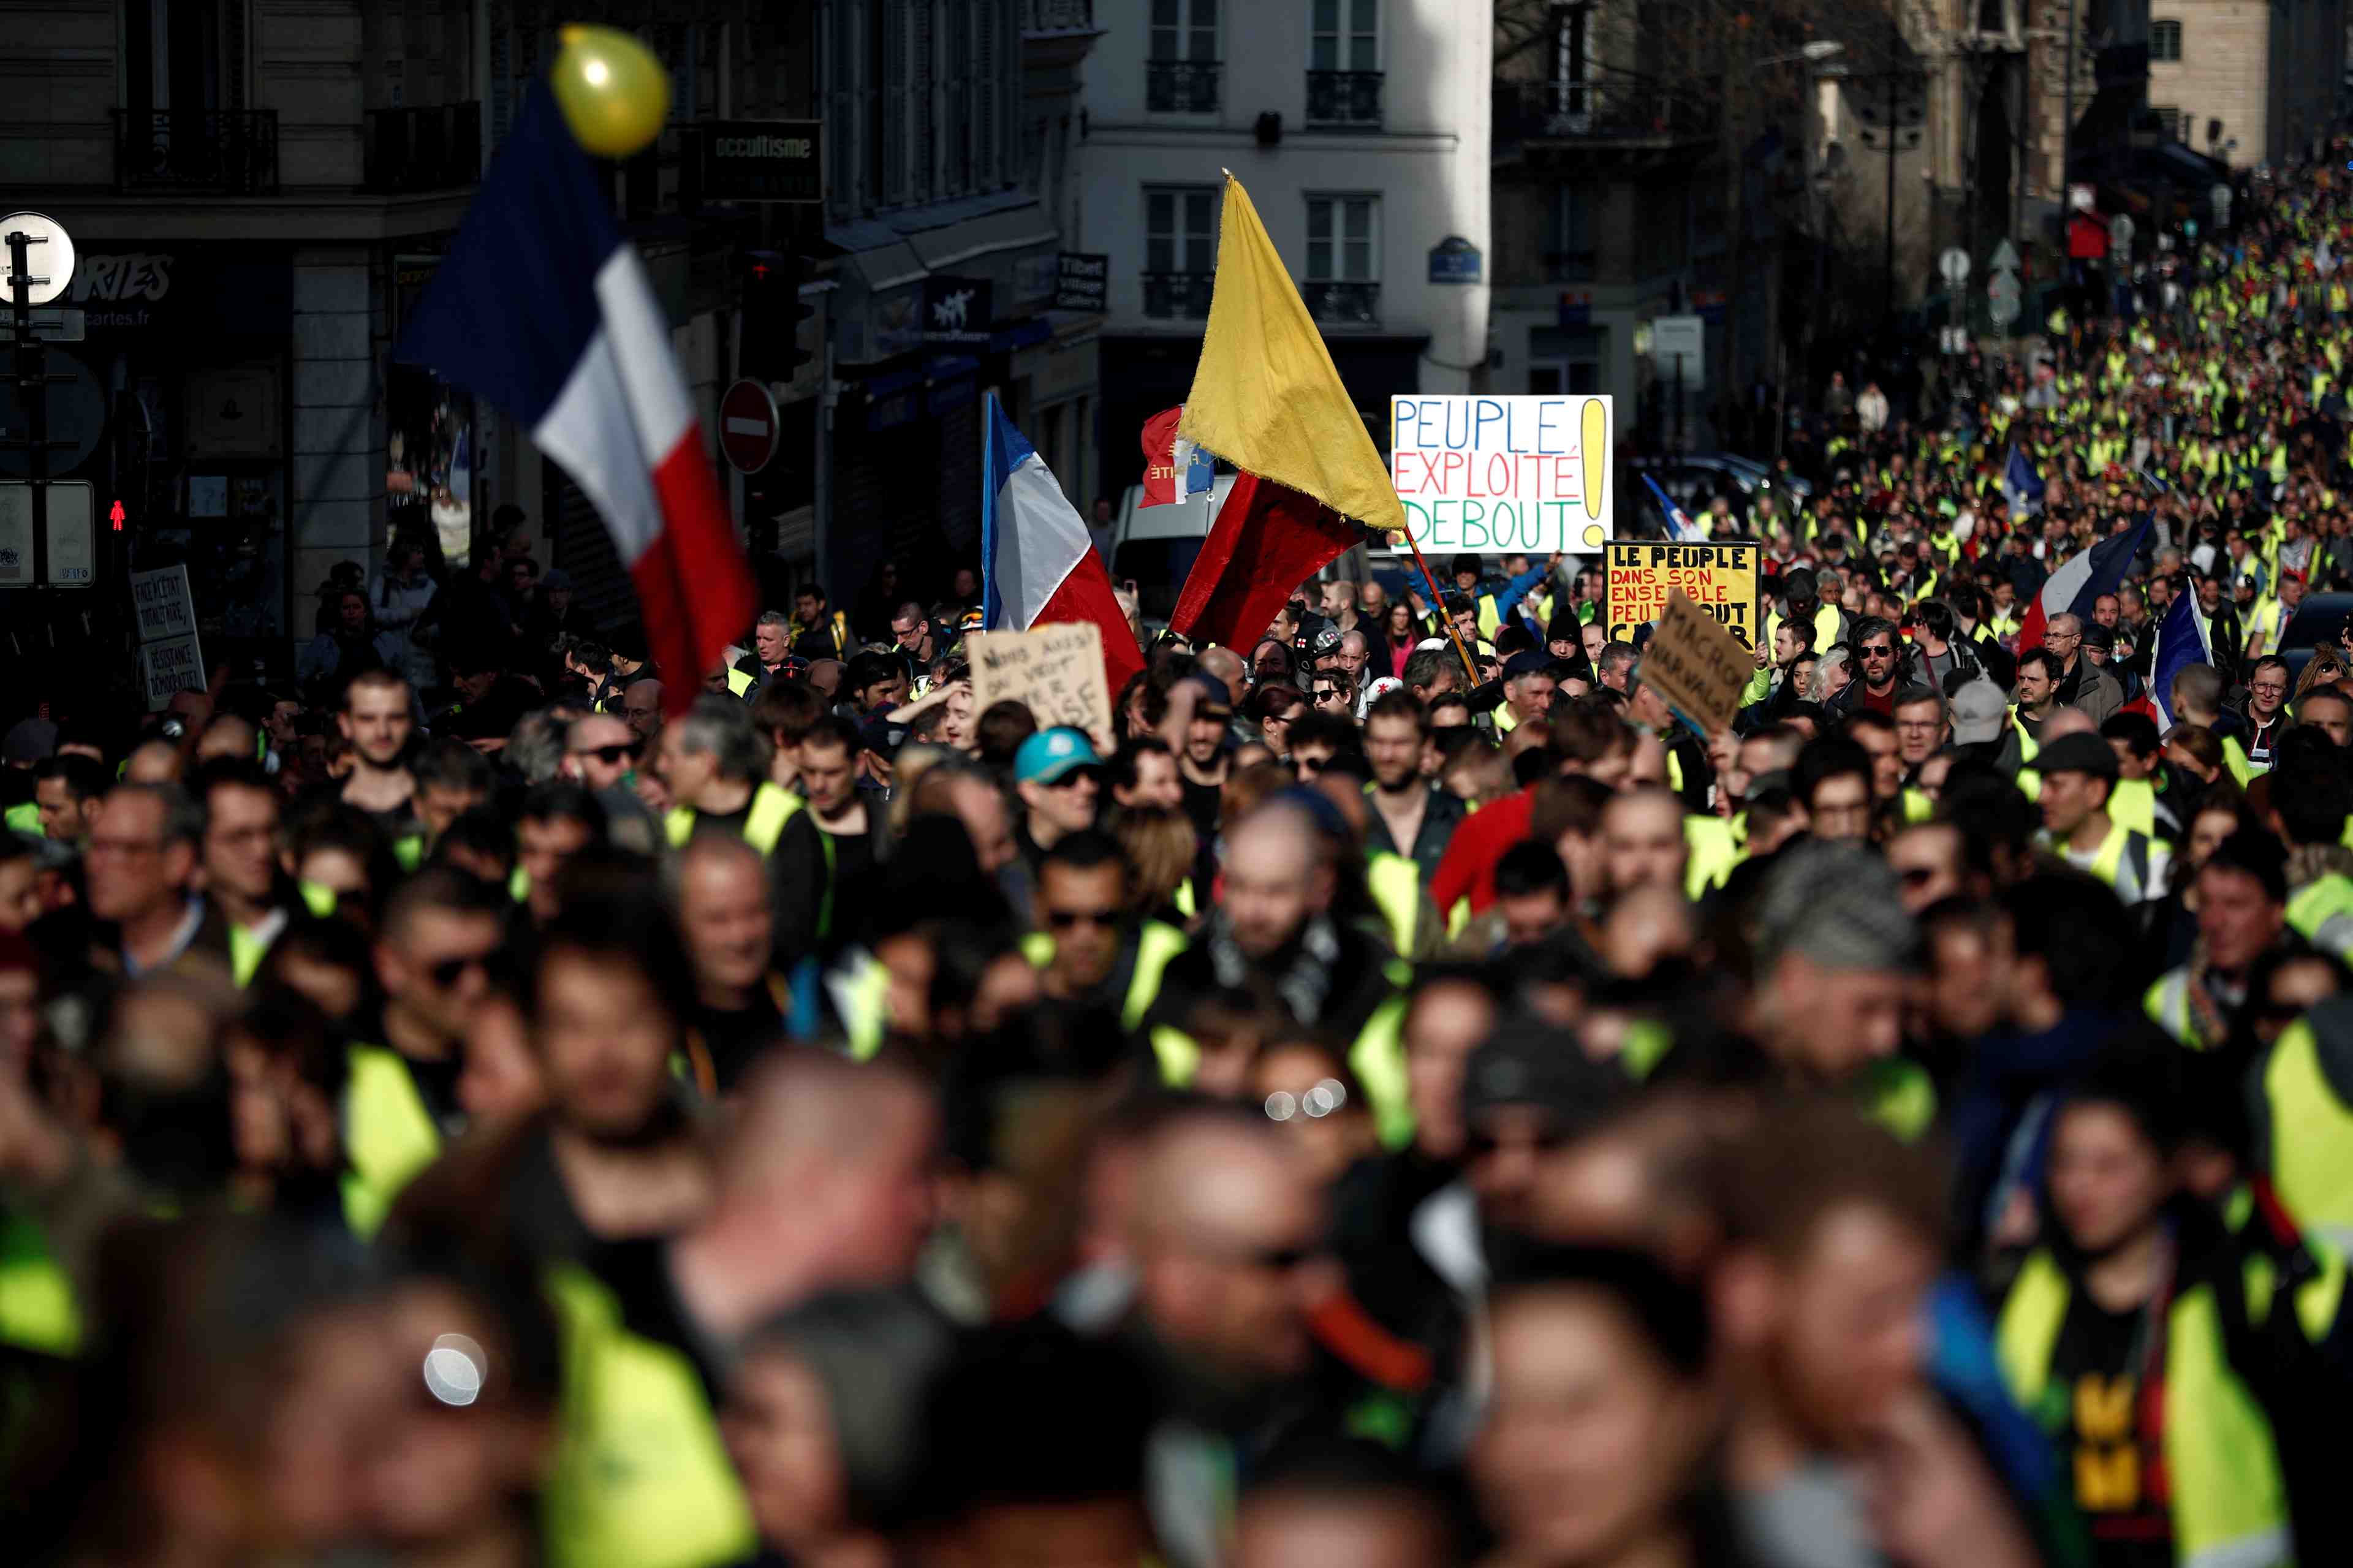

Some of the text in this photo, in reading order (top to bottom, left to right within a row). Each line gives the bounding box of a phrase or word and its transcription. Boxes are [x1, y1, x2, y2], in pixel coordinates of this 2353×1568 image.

[715, 134, 813, 159] occultisme
[1393, 400, 1566, 454] PEUPLE
[1394, 444, 1580, 499] EXPLOITÉ
[1393, 499, 1582, 551] DEBOUT
[1614, 547, 1748, 569] LE PEUPLE
[1610, 569, 1711, 586] DANS SON
[1611, 585, 1727, 602] ENSEBLE
